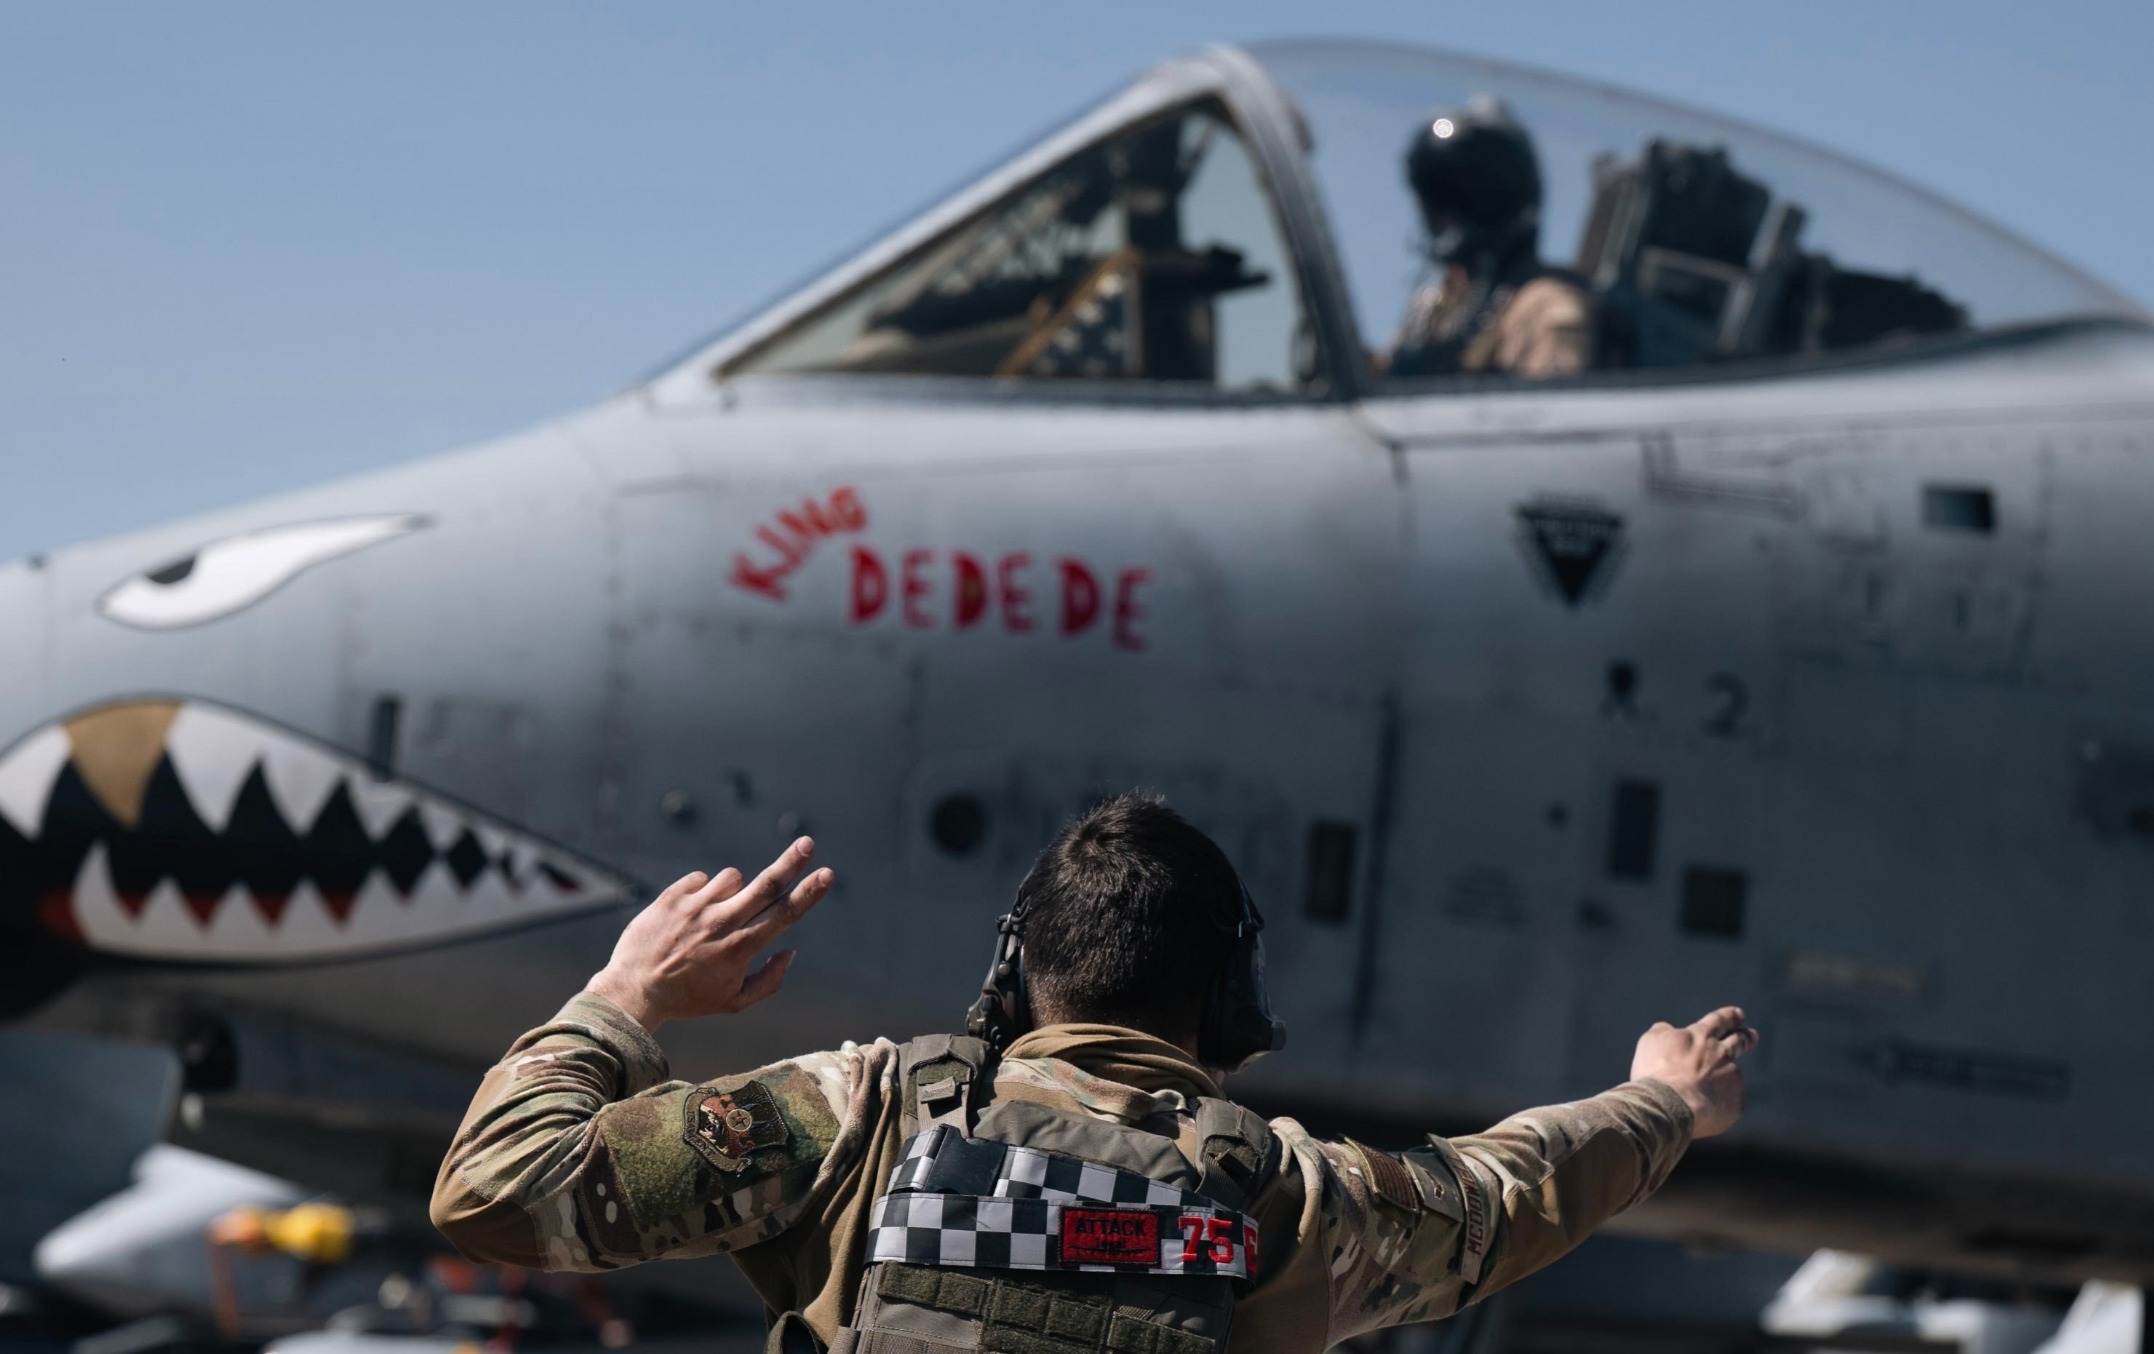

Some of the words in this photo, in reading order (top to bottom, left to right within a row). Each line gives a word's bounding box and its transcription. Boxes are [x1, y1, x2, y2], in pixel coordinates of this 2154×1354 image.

[729, 486, 867, 601] KING
[1075, 1217, 1146, 1237] ATTACK
[1178, 1216, 1234, 1263] 75
